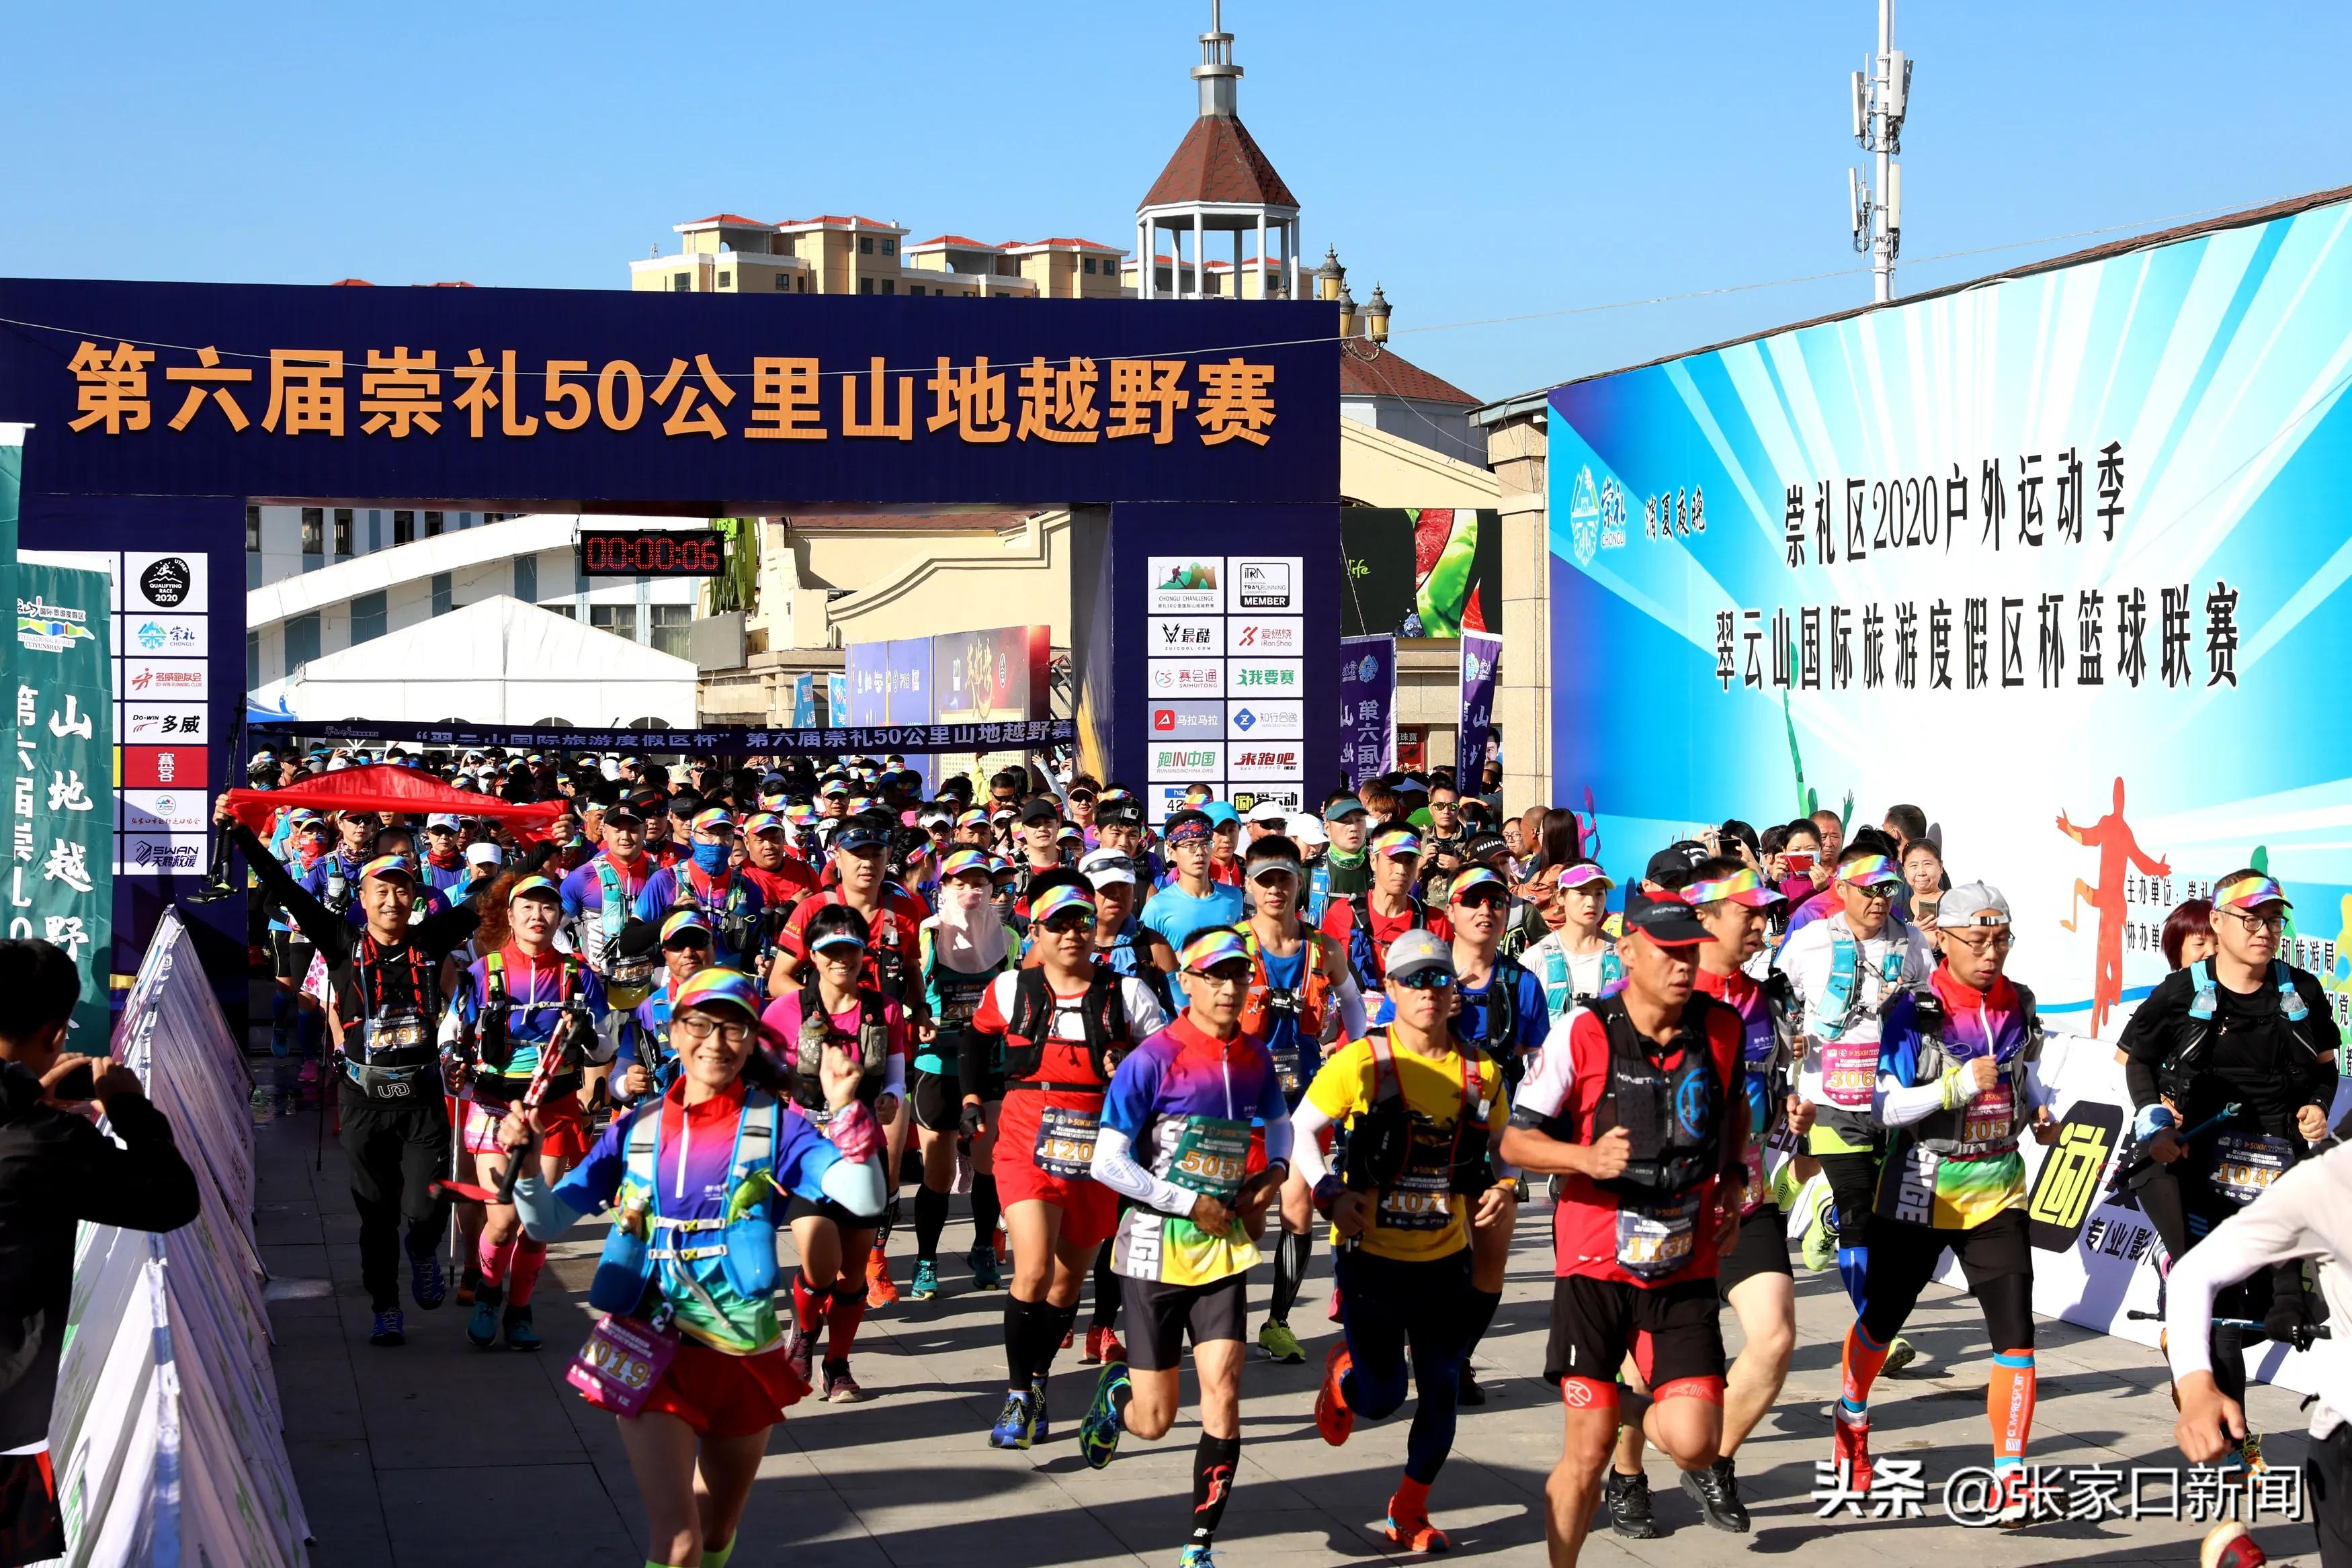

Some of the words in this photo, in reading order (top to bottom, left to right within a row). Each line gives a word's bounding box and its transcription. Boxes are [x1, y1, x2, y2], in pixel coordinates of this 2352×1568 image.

[67, 341, 1277, 447] 第六届崇礼50公里山地越野赛
[1601, 478, 1626, 529] 崇礼
[1784, 441, 2126, 568] 崇礼区2020户外运动季
[1646, 487, 1705, 540] 消夏夜晚
[1601, 532, 1625, 546] CHONGLI
[587, 537, 718, 571] 00:00:06
[155, 594, 178, 602] 2020
[1244, 597, 1286, 605] MEMBER
[18, 634, 54, 644] NTERNATIONAL
[169, 625, 196, 641] 崇礼
[1181, 628, 1211, 643] 最酷
[1261, 628, 1292, 640] 爱燃烧
[1716, 580, 2240, 691] 翠云山国际旅游度假区杯篮球联赛
[26, 642, 62, 651] CUIYUNSHAN
[155, 672, 202, 682] 多威跑友会
[1179, 668, 1217, 683] 赛会通
[1249, 669, 1295, 685] 我要赛
[161, 715, 200, 734] 多威
[1177, 714, 1218, 726] 马拉马拉
[746, 720, 1072, 749] 第六届崇礼50公里山地越野赛
[1157, 750, 1216, 768] 跑IN中国
[1234, 752, 1298, 765] 来跑吧
[153, 846, 199, 855] SWAN
[151, 855, 198, 867] 天鹅救援
[372, 1026, 424, 1047] 1091
